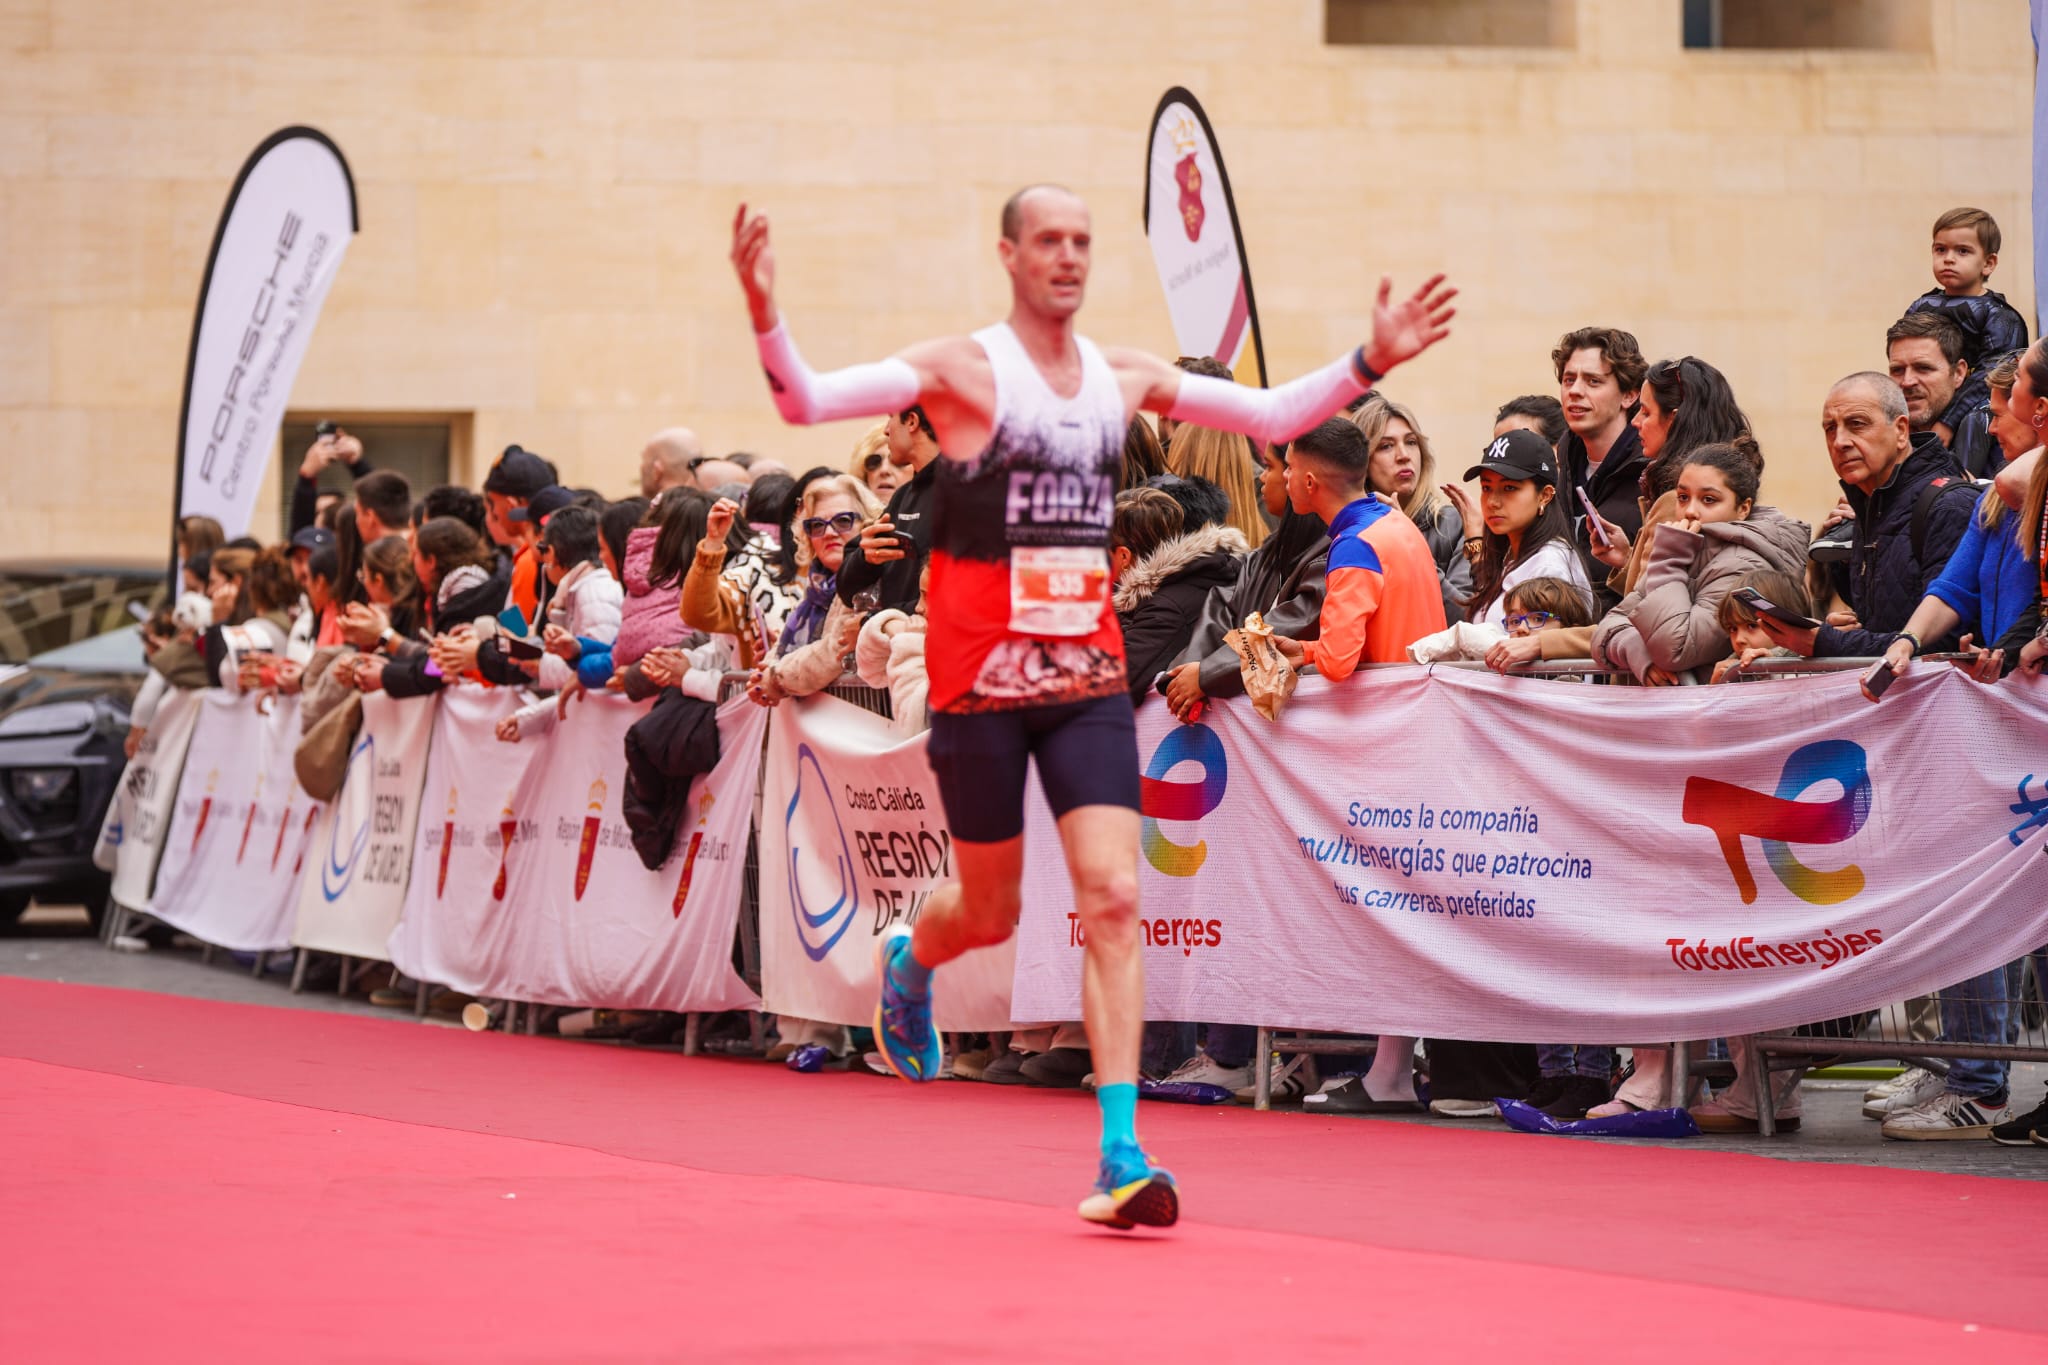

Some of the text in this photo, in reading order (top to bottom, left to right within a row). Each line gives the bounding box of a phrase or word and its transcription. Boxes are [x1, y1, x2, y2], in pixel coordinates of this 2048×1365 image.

[199, 210, 303, 484] PORSCHE
[220, 231, 330, 501] Centro Porsche Murcia
[1489, 437, 1510, 457] NY
[1005, 471, 1115, 527] FORZA
[845, 784, 926, 812] Costa Cálida
[1347, 802, 1538, 835] Somos la compañía
[1297, 833, 1592, 879] multienergías que patrocina
[1334, 880, 1536, 919] tus carreras preferidas
[1665, 929, 1884, 971] TotalEnergies
